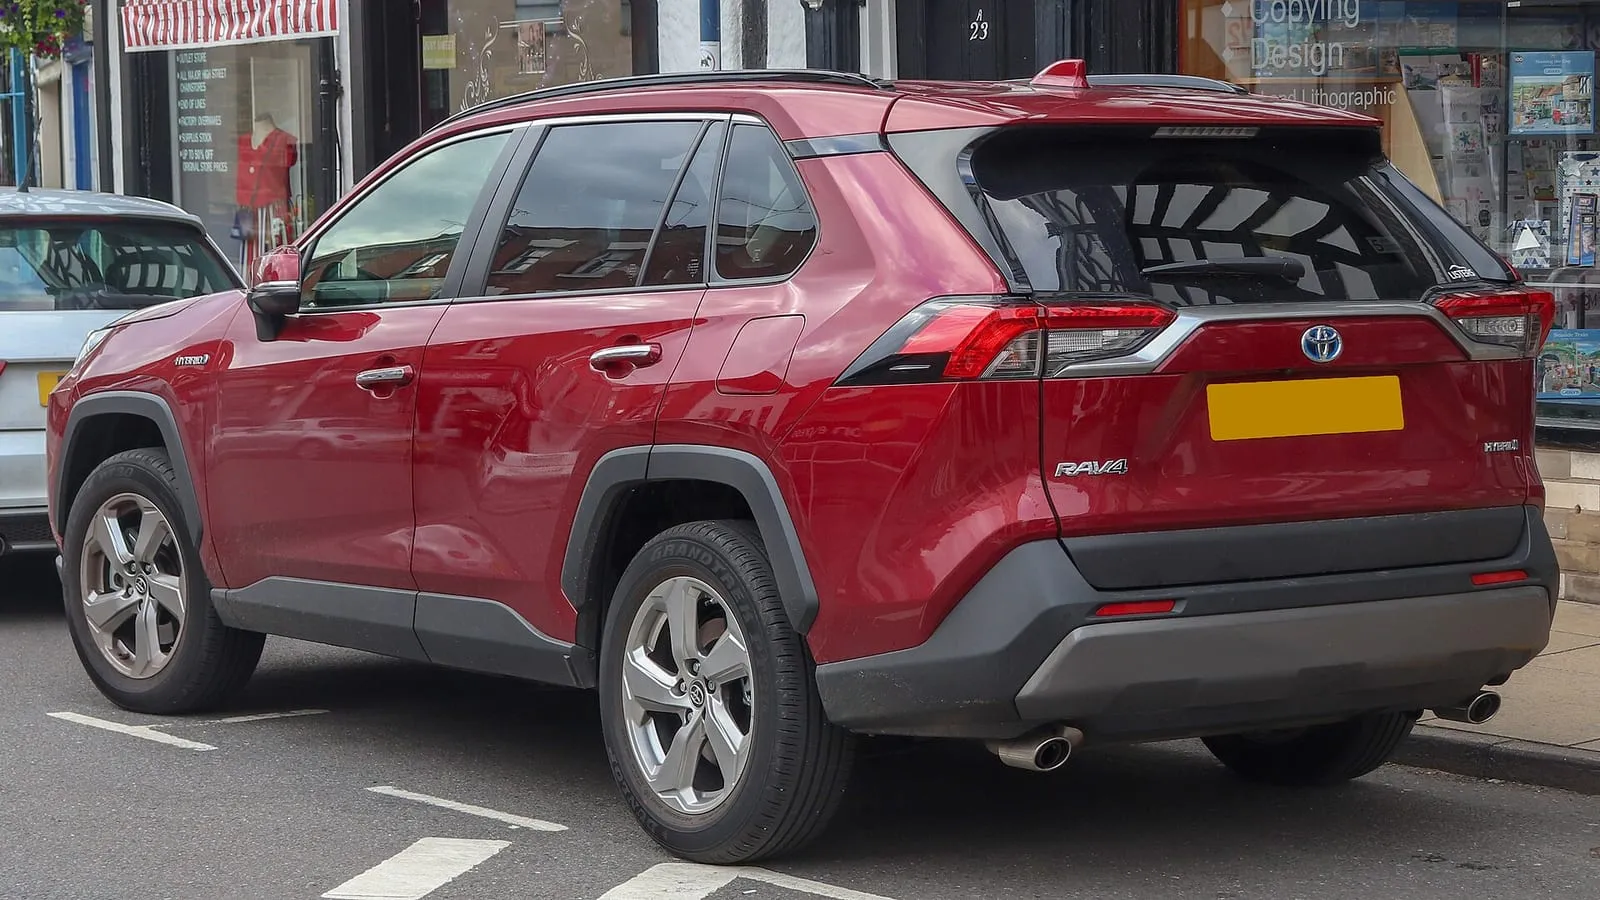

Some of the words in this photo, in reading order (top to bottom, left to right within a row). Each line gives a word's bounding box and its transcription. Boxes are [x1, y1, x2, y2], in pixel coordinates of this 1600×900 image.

[1250, 0, 1360, 29] Copying
[969, 21, 989, 41] 23
[1251, 37, 1344, 76] Design
[1302, 86, 1397, 111] Lithographic
[1447, 268, 1476, 280] LISTERS
[1054, 458, 1128, 477] RAV4
